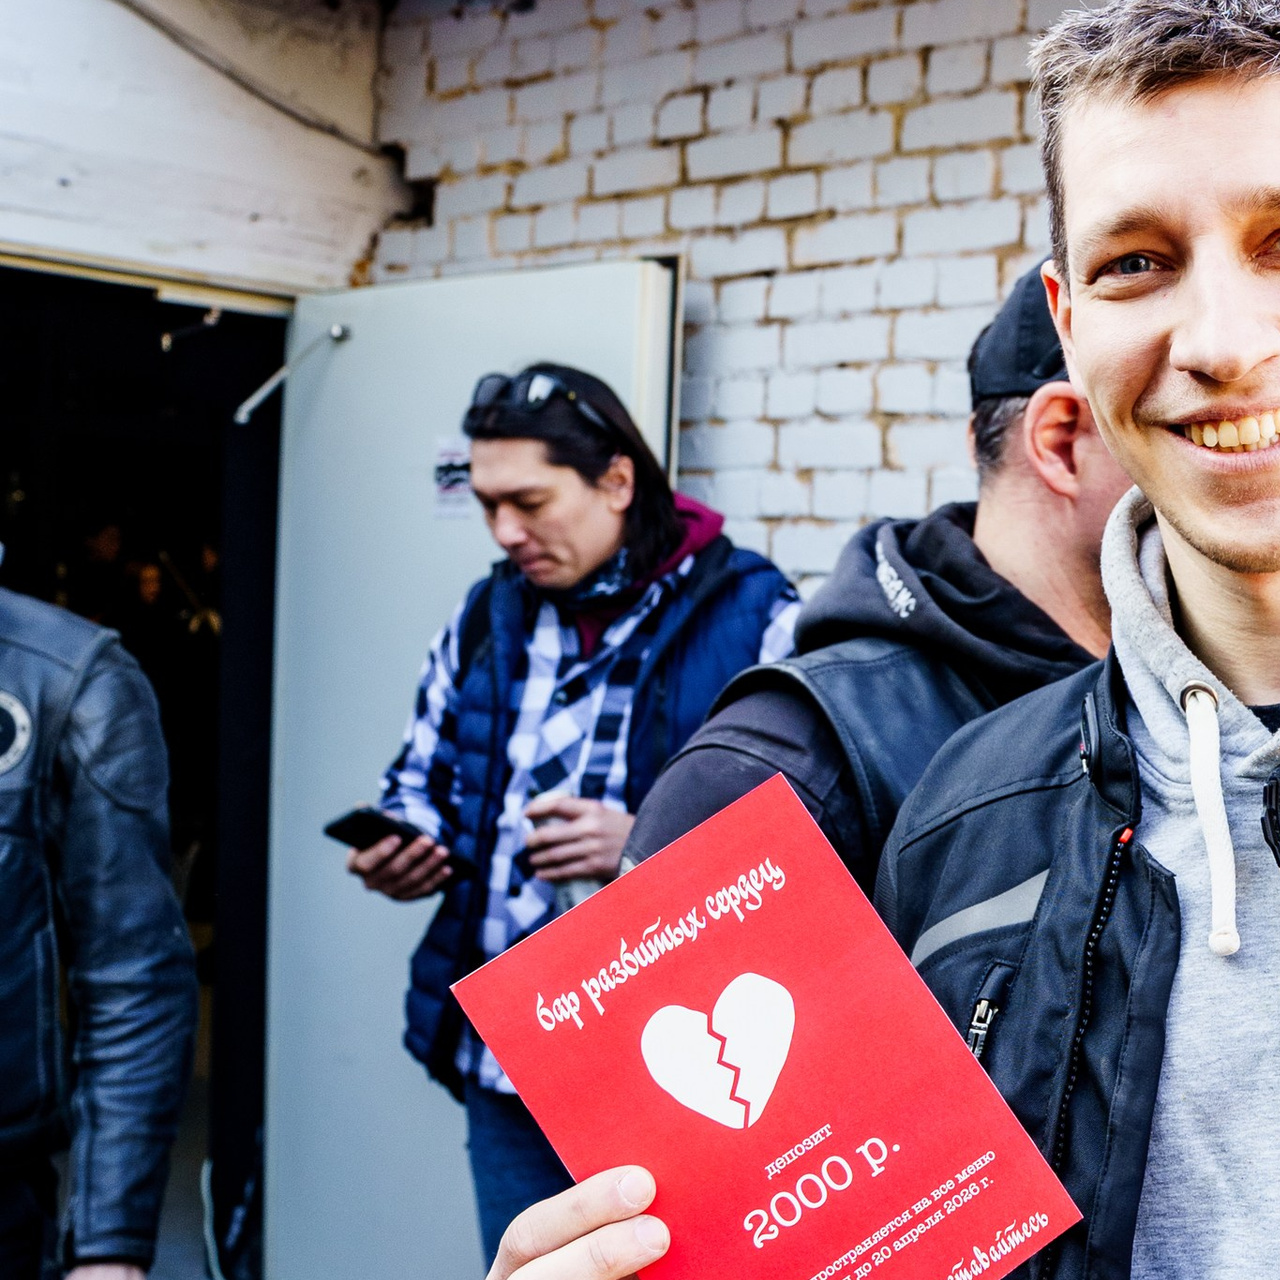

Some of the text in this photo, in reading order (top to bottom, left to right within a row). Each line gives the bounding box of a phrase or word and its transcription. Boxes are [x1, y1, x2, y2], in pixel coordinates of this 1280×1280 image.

[535, 857, 786, 1032] бар разбитых сердец
[743, 1137, 901, 1249] 2000 р.
[764, 1123, 833, 1181] депозит
[910, 1197, 933, 1215] на
[930, 1179, 956, 1202] все
[954, 1150, 996, 1184] меню
[871, 1245, 892, 1266] 20
[892, 1209, 946, 1252] апреля
[943, 1182, 980, 1215] 2026
[979, 1176, 994, 1189] г.
